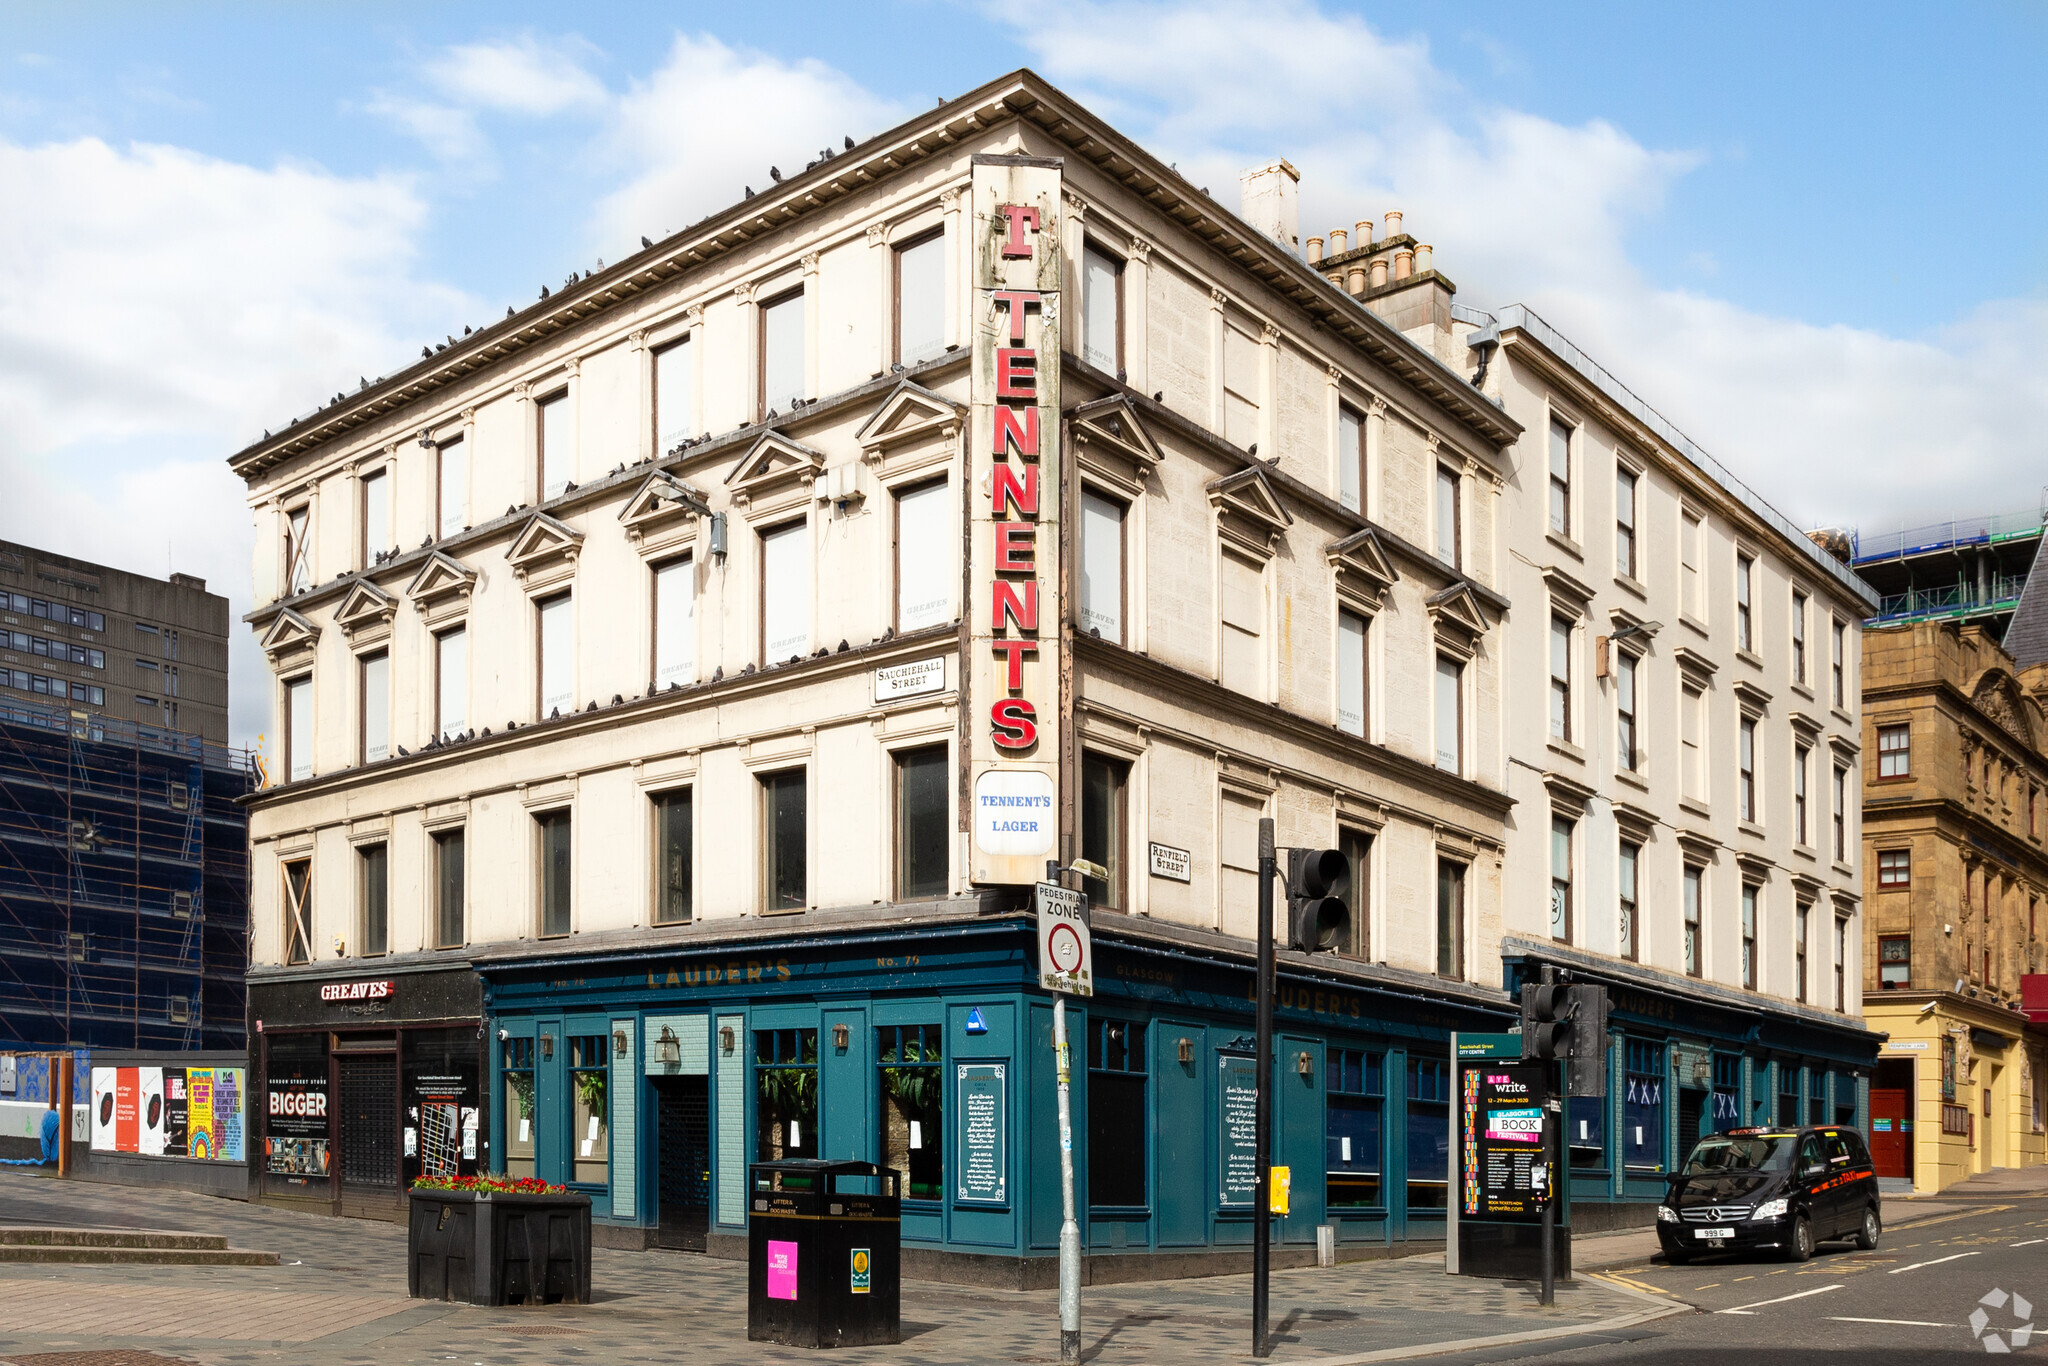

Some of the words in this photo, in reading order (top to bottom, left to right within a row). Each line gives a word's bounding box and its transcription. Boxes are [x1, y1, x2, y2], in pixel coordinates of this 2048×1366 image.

[991, 291, 1041, 750] TENNENTS
[907, 598, 947, 615] GREAVES
[771, 634, 807, 649] GREAVES
[661, 661, 693, 675] GREAVES
[878, 661, 941, 681] SAUCHIEHALL
[891, 675, 927, 690] STREET
[981, 795, 1051, 807] TENNENT'S
[992, 821, 1039, 832] LAGER
[1153, 846, 1189, 863] RENFIELD
[1157, 858, 1185, 873] STREET
[1047, 901, 1080, 920] ZONE
[877, 957, 898, 967] No.
[648, 957, 792, 990] LAUDER'S
[1116, 964, 1175, 984] GLASGOW
[321, 981, 389, 1000] GREAVES
[1489, 1075, 1509, 1083] AYE
[269, 1092, 326, 1116] BIGGER
[1501, 1120, 1537, 1130] BOOK
[1496, 1132, 1528, 1140] FESTIVAL
[1841, 1170, 1856, 1183] TAXI
